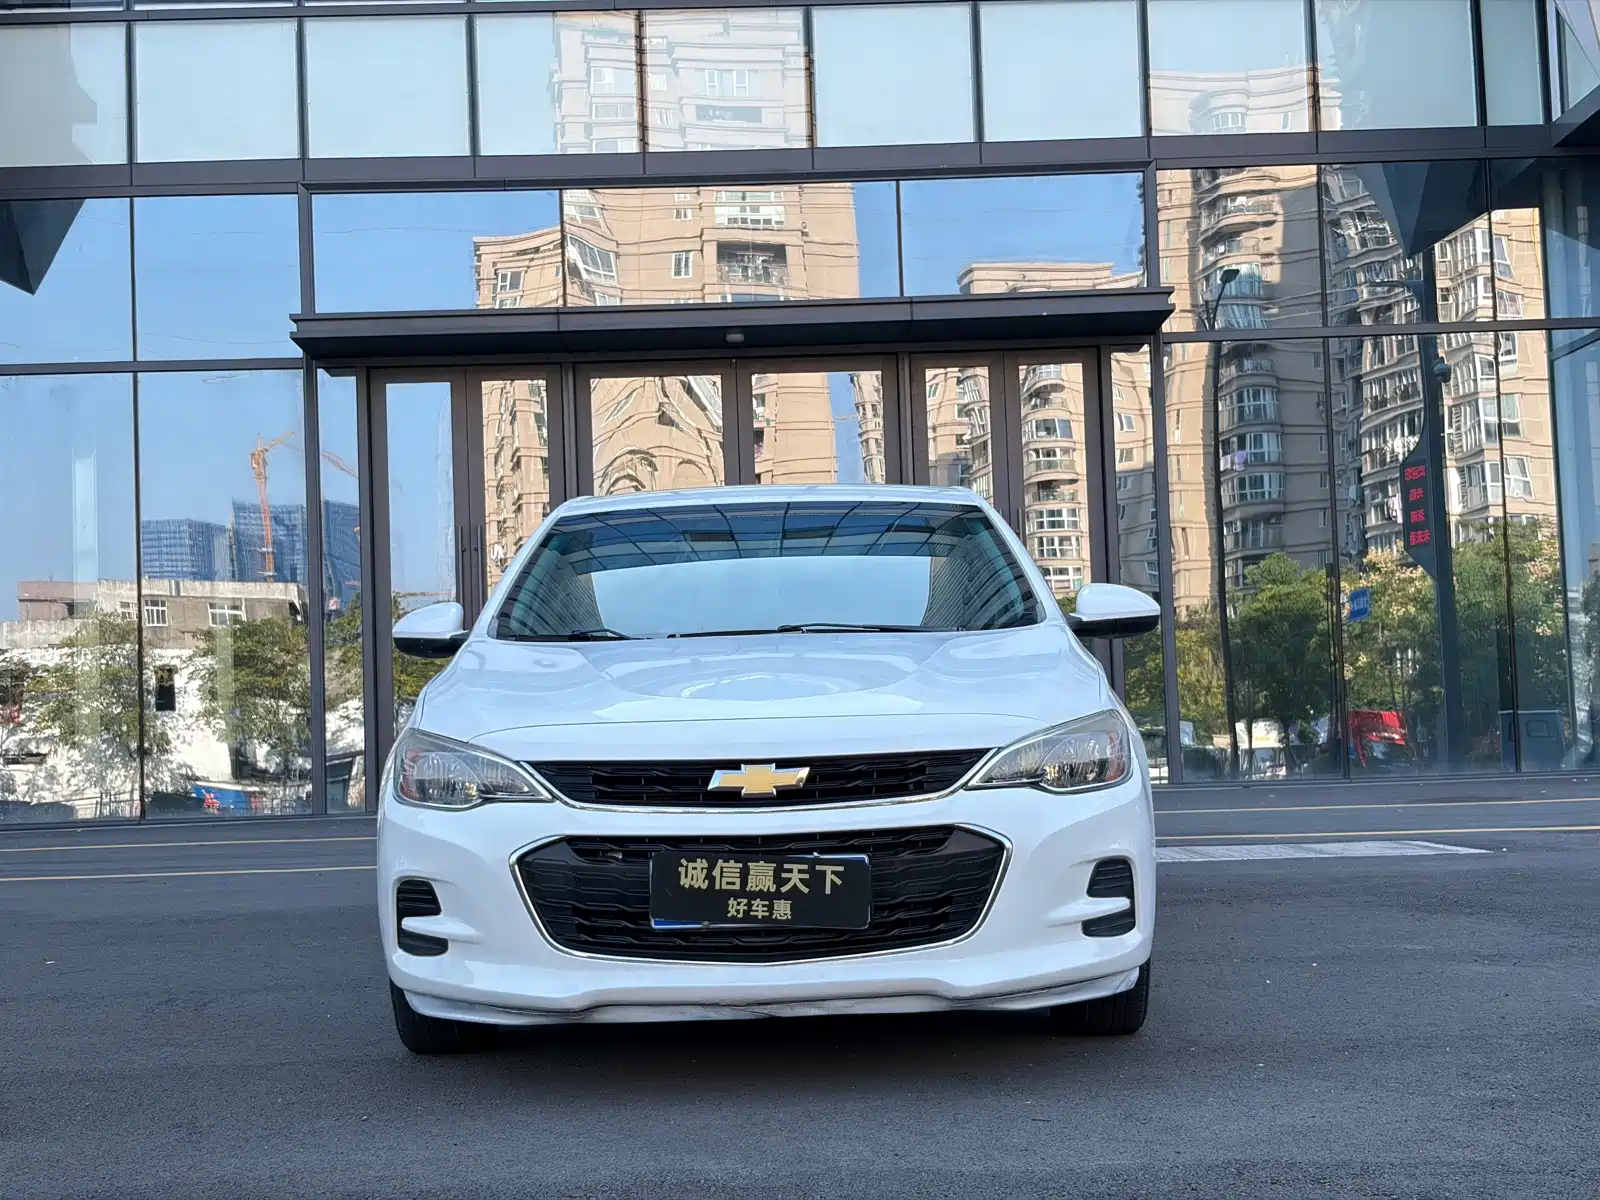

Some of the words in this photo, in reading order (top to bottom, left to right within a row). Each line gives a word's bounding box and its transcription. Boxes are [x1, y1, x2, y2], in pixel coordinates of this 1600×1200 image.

[678, 858, 845, 895] 诚信赢天下
[727, 897, 792, 920] 好车惠
